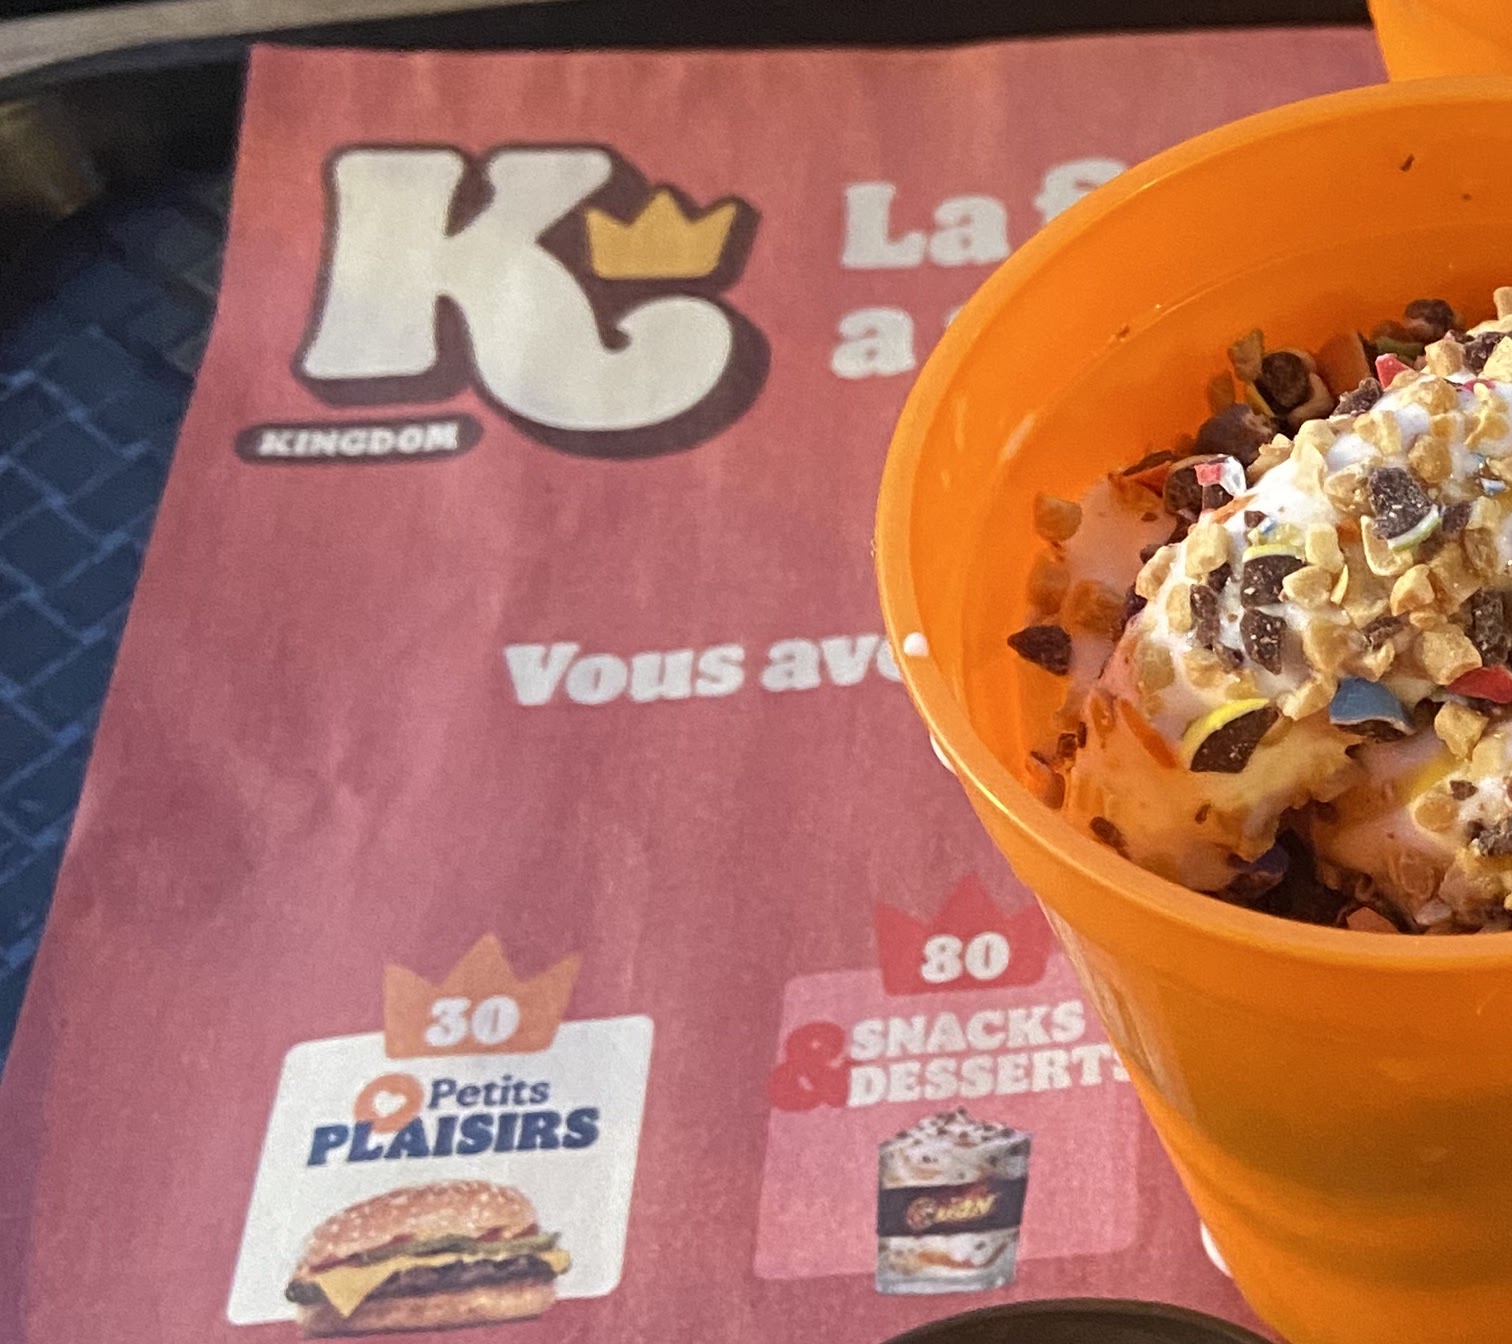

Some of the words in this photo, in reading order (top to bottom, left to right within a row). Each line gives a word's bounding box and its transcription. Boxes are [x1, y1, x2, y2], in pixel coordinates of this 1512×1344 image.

[840, 178, 1011, 268] La
[829, 306, 916, 378] a
[258, 421, 459, 456] KINGDOM
[502, 640, 746, 706] Vous
[920, 932, 1011, 984] 80
[424, 994, 520, 1047] 30
[849, 999, 1086, 1062] SNACKS
[428, 1074, 550, 1110] Petits
[306, 1106, 601, 1167] PLAISIRS
